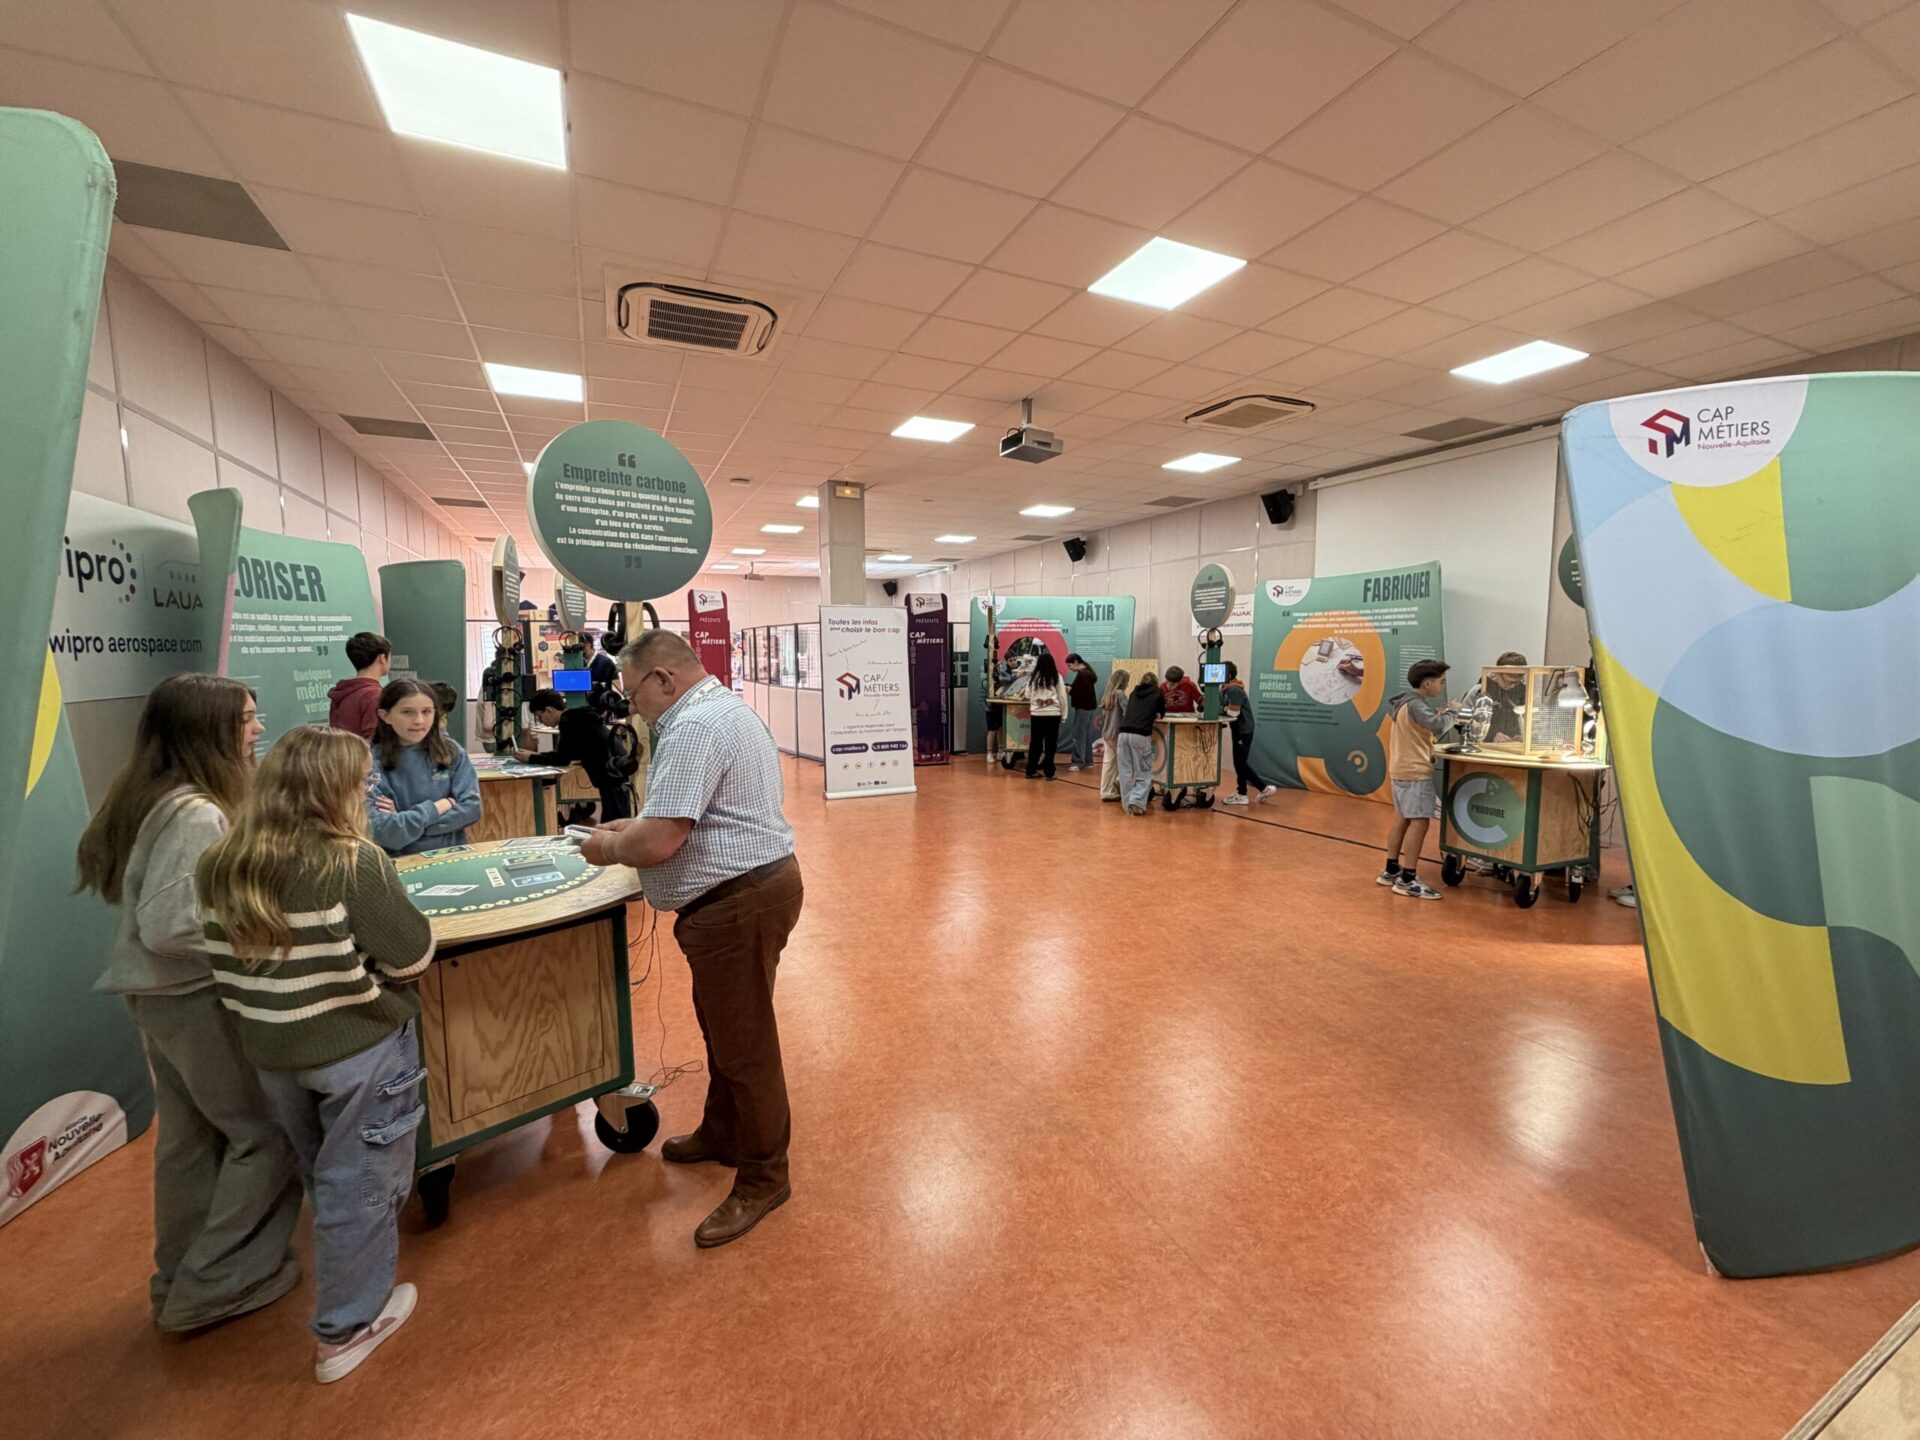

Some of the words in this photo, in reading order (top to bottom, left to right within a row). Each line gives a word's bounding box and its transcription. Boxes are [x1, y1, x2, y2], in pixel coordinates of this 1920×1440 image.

[1697, 406, 1734, 423] CAP
[1698, 420, 1770, 440] MÉTIERS
[1698, 438, 1770, 450] Nouvelle-Aquitaine
[563, 462, 632, 487] Empreinte
[636, 476, 686, 493] carbone
[555, 492, 564, 500] de
[592, 487, 615, 496] carbone
[617, 489, 630, 498] c'est
[568, 526, 577, 534] La
[577, 528, 618, 538] concentration
[64, 536, 125, 593] ipro
[234, 555, 327, 603] ORISER
[1362, 570, 1431, 603] FABRIQUER
[153, 587, 203, 611] LAUA
[1076, 600, 1115, 622] BÂTIR
[828, 618, 850, 626] Toutes
[851, 618, 861, 626] les
[862, 618, 879, 626] infos
[694, 631, 710, 639] CAP
[887, 627, 901, 635] cap
[909, 631, 926, 639] CAP
[49, 627, 104, 662] wipro
[108, 636, 177, 657] aerospace
[180, 638, 202, 653] com
[293, 668, 332, 682] Quelques
[863, 674, 881, 683] CAP
[864, 683, 900, 693] MÉTIERS
[1259, 680, 1293, 691] métiers
